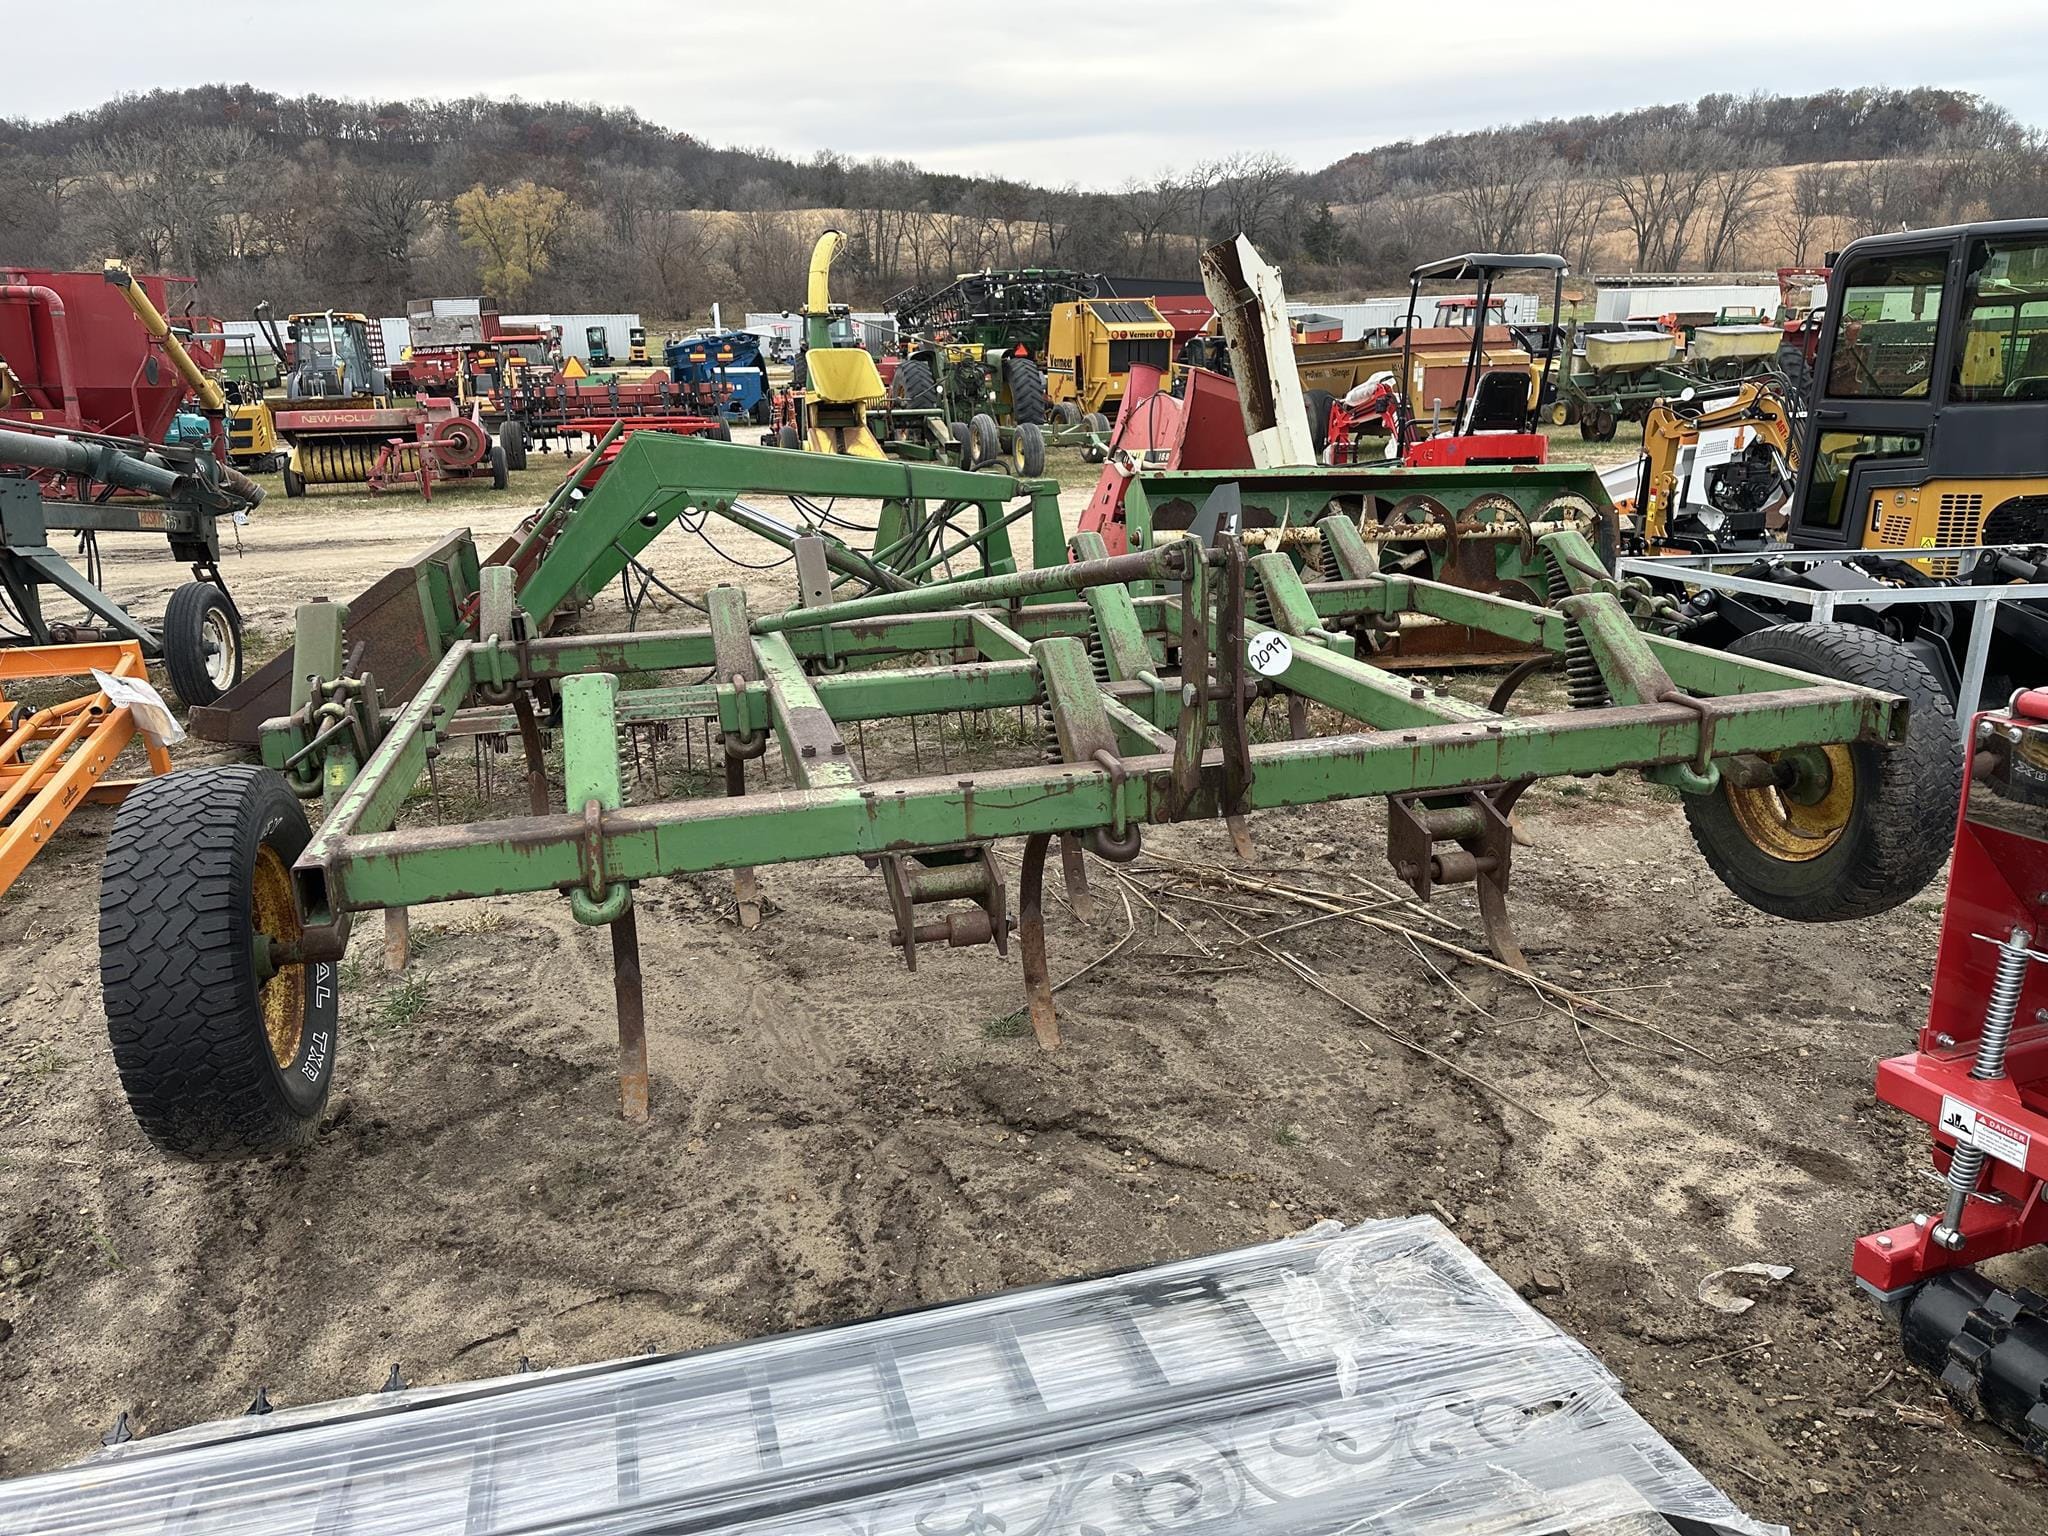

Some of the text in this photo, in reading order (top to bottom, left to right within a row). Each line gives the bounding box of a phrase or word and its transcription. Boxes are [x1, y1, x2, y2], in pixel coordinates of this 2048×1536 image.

[1129, 331, 1156, 339] Vermeer
[1049, 353, 1073, 368] Vermeer
[301, 415, 332, 424] NEW
[1250, 636, 1288, 670] 2099
[301, 1031, 329, 1082] TXR
[1989, 1120, 2026, 1143] DANGER
